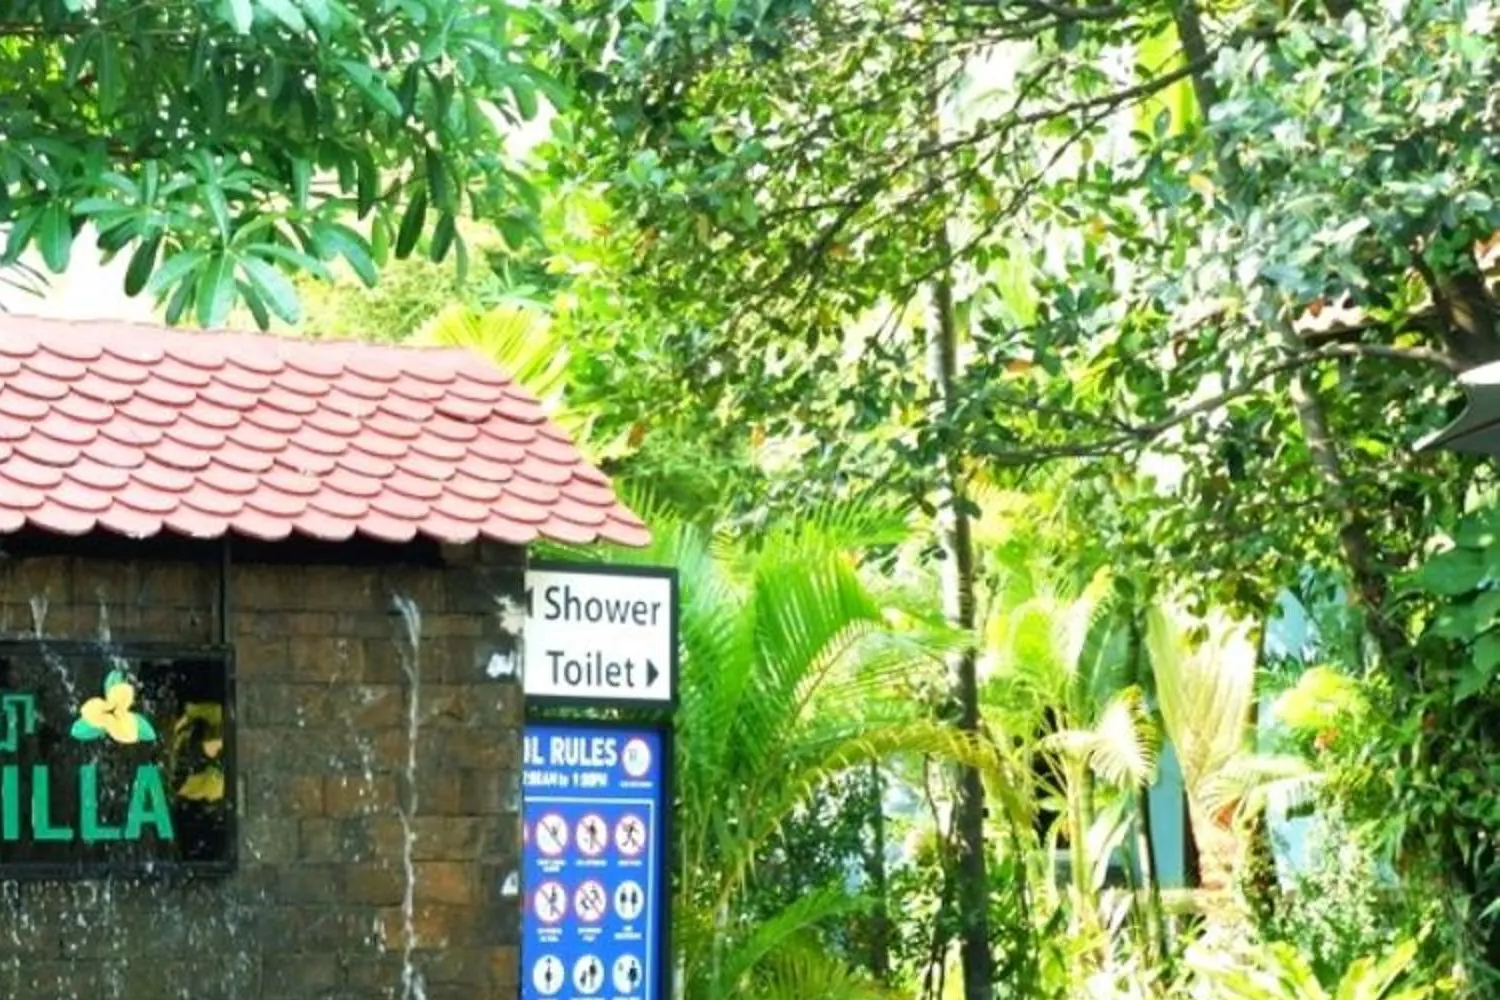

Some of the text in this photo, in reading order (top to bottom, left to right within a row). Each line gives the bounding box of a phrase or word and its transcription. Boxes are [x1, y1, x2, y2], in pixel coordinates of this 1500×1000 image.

[544, 584, 661, 626] Shower
[546, 650, 636, 688] Toilet
[550, 735, 618, 768] RULES
